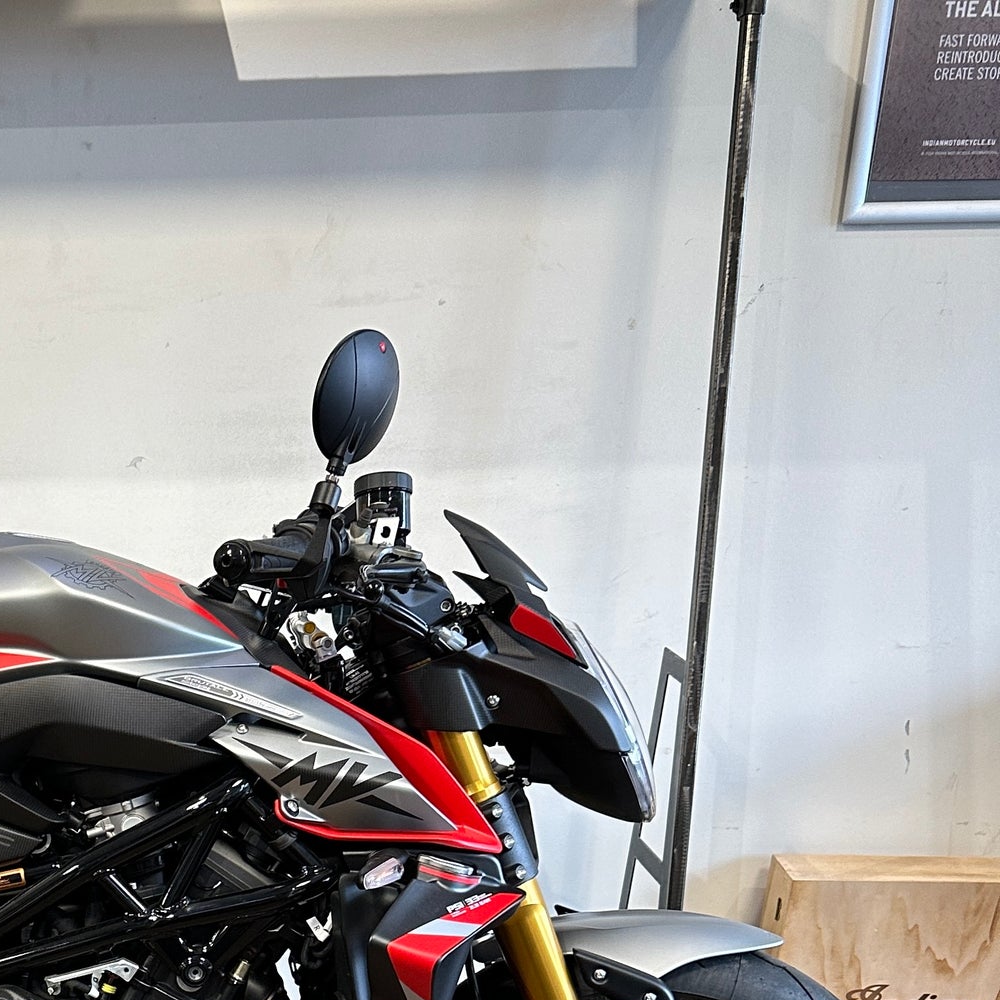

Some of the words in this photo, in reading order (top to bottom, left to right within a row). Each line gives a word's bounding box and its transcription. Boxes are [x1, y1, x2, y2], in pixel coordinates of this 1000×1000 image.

[945, 0, 980, 18] THE
[939, 33, 965, 48] FAST
[934, 67, 974, 81] CREATE
[922, 138, 997, 147] INDIANMOTORCYCLE.EU
[250, 743, 415, 816] MV
